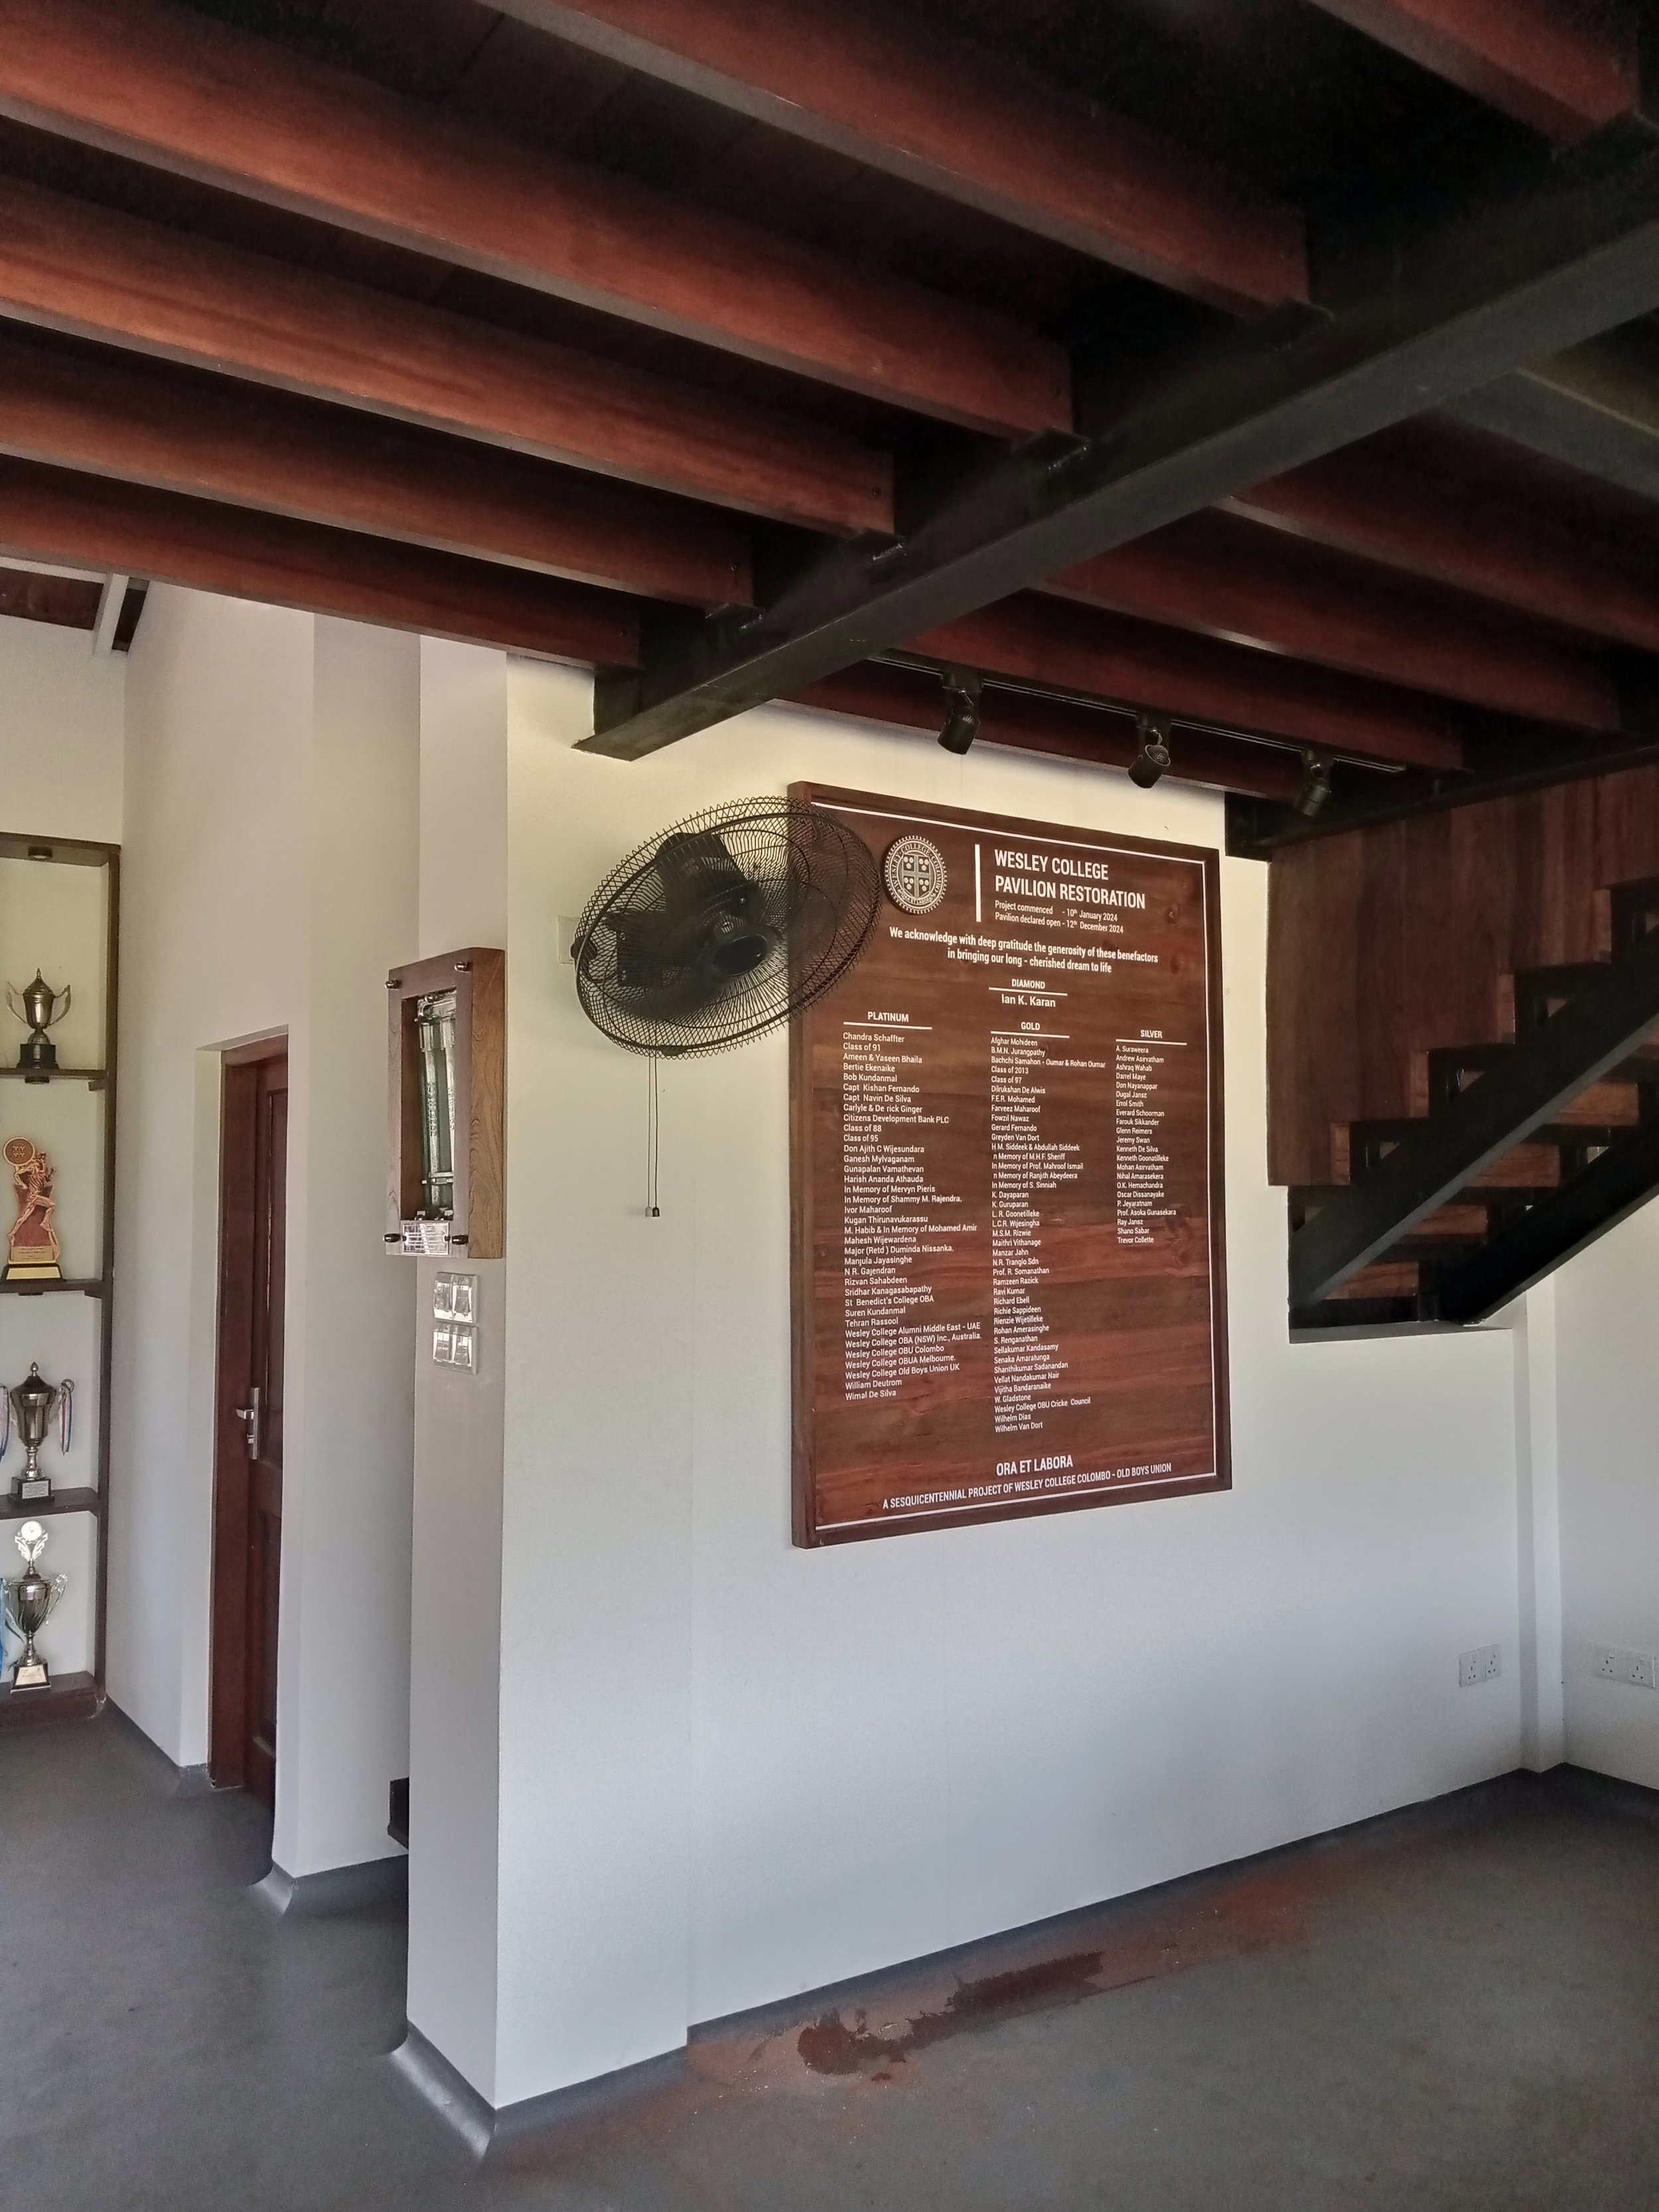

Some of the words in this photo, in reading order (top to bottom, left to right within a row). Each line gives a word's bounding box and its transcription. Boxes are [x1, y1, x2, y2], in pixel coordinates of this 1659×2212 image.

[901, 843, 930, 856] COLLEGE
[993, 848, 1048, 872] WESLEY
[1051, 857, 1109, 881] COLLEGE
[995, 874, 1056, 899] PAVILION
[1059, 883, 1145, 909] RESTORATION
[994, 899, 1017, 911] Project
[1017, 904, 1053, 915] commenced
[1078, 909, 1102, 922] January
[1102, 912, 1118, 922] 2024
[995, 911, 1019, 922] Pavilion
[1019, 914, 1045, 925] declared
[1045, 919, 1061, 928] open
[1079, 921, 1108, 932] December
[1108, 924, 1123, 934] 2024
[889, 926, 903, 938] We
[904, 928, 958, 946] acknowledge
[958, 933, 976, 946] with
[977, 934, 997, 950] deep
[997, 938, 1033, 951] gratitude
[1033, 941, 1046, 952] the
[1047, 944, 1086, 958] generosity
[1087, 946, 1096, 957] of
[1096, 946, 1116, 959] these
[1117, 948, 1159, 963] benefactors
[947, 946, 956, 959] in
[956, 948, 989, 964] bringing
[990, 954, 1004, 964] our
[1005, 953, 1022, 968] long
[1029, 955, 1065, 969] cherished
[1066, 959, 1090, 971] dream
[1090, 962, 1099, 972] to
[1100, 962, 1112, 973] life
[1011, 978, 1045, 990] DIAMOND
[1001, 993, 1016, 1004] Ian
[1017, 994, 1027, 1005] K.
[1029, 995, 1056, 1007] Karan
[867, 1011, 909, 1022] PLATINUM
[1020, 1021, 1041, 1031] GOLD
[843, 1031, 872, 1041] Chandra
[873, 1033, 904, 1043] Schaffter
[1139, 1029, 1163, 1039] SILVER
[843, 1041, 863, 1051] Class
[863, 1043, 871, 1051] of
[842, 1052, 867, 1061] Ameen
[875, 1053, 901, 1063] Yaseen
[901, 1055, 922, 1063] Bhaila
[843, 1062, 864, 1070] Bertie
[865, 1063, 895, 1072] Ekenaike
[990, 1065, 1007, 1073] Class
[1014, 1066, 1029, 1074] 2013
[843, 1072, 857, 1080] Bob
[858, 1073, 897, 1082] Kundanmal
[990, 1074, 1007, 1083] Class
[843, 1113, 871, 1122] Citizens
[872, 1114, 916, 1124] Development
[843, 1123, 863, 1132] Class
[843, 1133, 861, 1142] Class
[869, 1134, 879, 1142] 95
[843, 1154, 870, 1163] Ganesh
[871, 1154, 914, 1164] Mylvaganam
[843, 1164, 881, 1174] Gunapalan
[881, 1164, 924, 1173] Vamathevan
[843, 1174, 867, 1183] Harish
[867, 1174, 894, 1183] Ananda
[895, 1174, 924, 1183] Athauda
[843, 1185, 851, 1193] In
[852, 1185, 881, 1195] Memory
[881, 1184, 890, 1193] of
[890, 1185, 915, 1195] Mervyn
[916, 1184, 936, 1193] Pieris
[843, 1205, 858, 1214] Ivor
[859, 1205, 893, 1213] Maharoof
[843, 1236, 872, 1244] Mahesh
[873, 1234, 916, 1245] Wijewardena
[844, 1277, 868, 1286] Rizvan
[869, 1276, 907, 1285] Sahabdeen
[993, 1287, 1006, 1295] Ravi
[993, 1296, 1015, 1305] Richard
[1015, 1295, 1030, 1304] Ebell
[844, 1309, 865, 1317] Suren
[867, 1305, 906, 1316] Kundanmal
[844, 1319, 869, 1327] Tehran
[871, 1316, 899, 1326] Rassool
[993, 1326, 1012, 1335] Rohan
[1013, 1323, 1050, 1333] Amerasinghe
[844, 1349, 870, 1359] Wesley
[871, 1348, 897, 1357] College
[898, 1346, 913, 1355] OBU
[914, 1344, 944, 1353] Colombo
[845, 1370, 871, 1380] Wesley
[871, 1368, 897, 1378] College
[898, 1366, 910, 1375] Old
[910, 1366, 928, 1375] Boys
[928, 1364, 948, 1372] Union
[949, 1363, 960, 1371] UK
[845, 1380, 871, 1390] William
[872, 1379, 902, 1388] Deutrom
[845, 1390, 867, 1400] Wimal
[879, 1388, 897, 1398] Silva
[994, 1423, 1018, 1433] Wilhelm
[1030, 1421, 1043, 1430] Dort
[996, 1461, 1017, 1476] ORA
[1019, 1459, 1032, 1473] ET
[1033, 1454, 1073, 1471] LABORA
[882, 1499, 889, 1509] A
[890, 1488, 967, 1509] SESQUICENTENNIAL
[968, 1483, 1002, 1498] PROJECT
[1003, 1482, 1013, 1493] OF
[1013, 1478, 1043, 1492] WESLEY
[1044, 1474, 1076, 1488] COLLEGE
[1076, 1470, 1111, 1483] COLOMBO
[1116, 1467, 1130, 1478] OLD
[1131, 1465, 1149, 1477] BOYS
[1149, 1462, 1171, 1474] UNION
